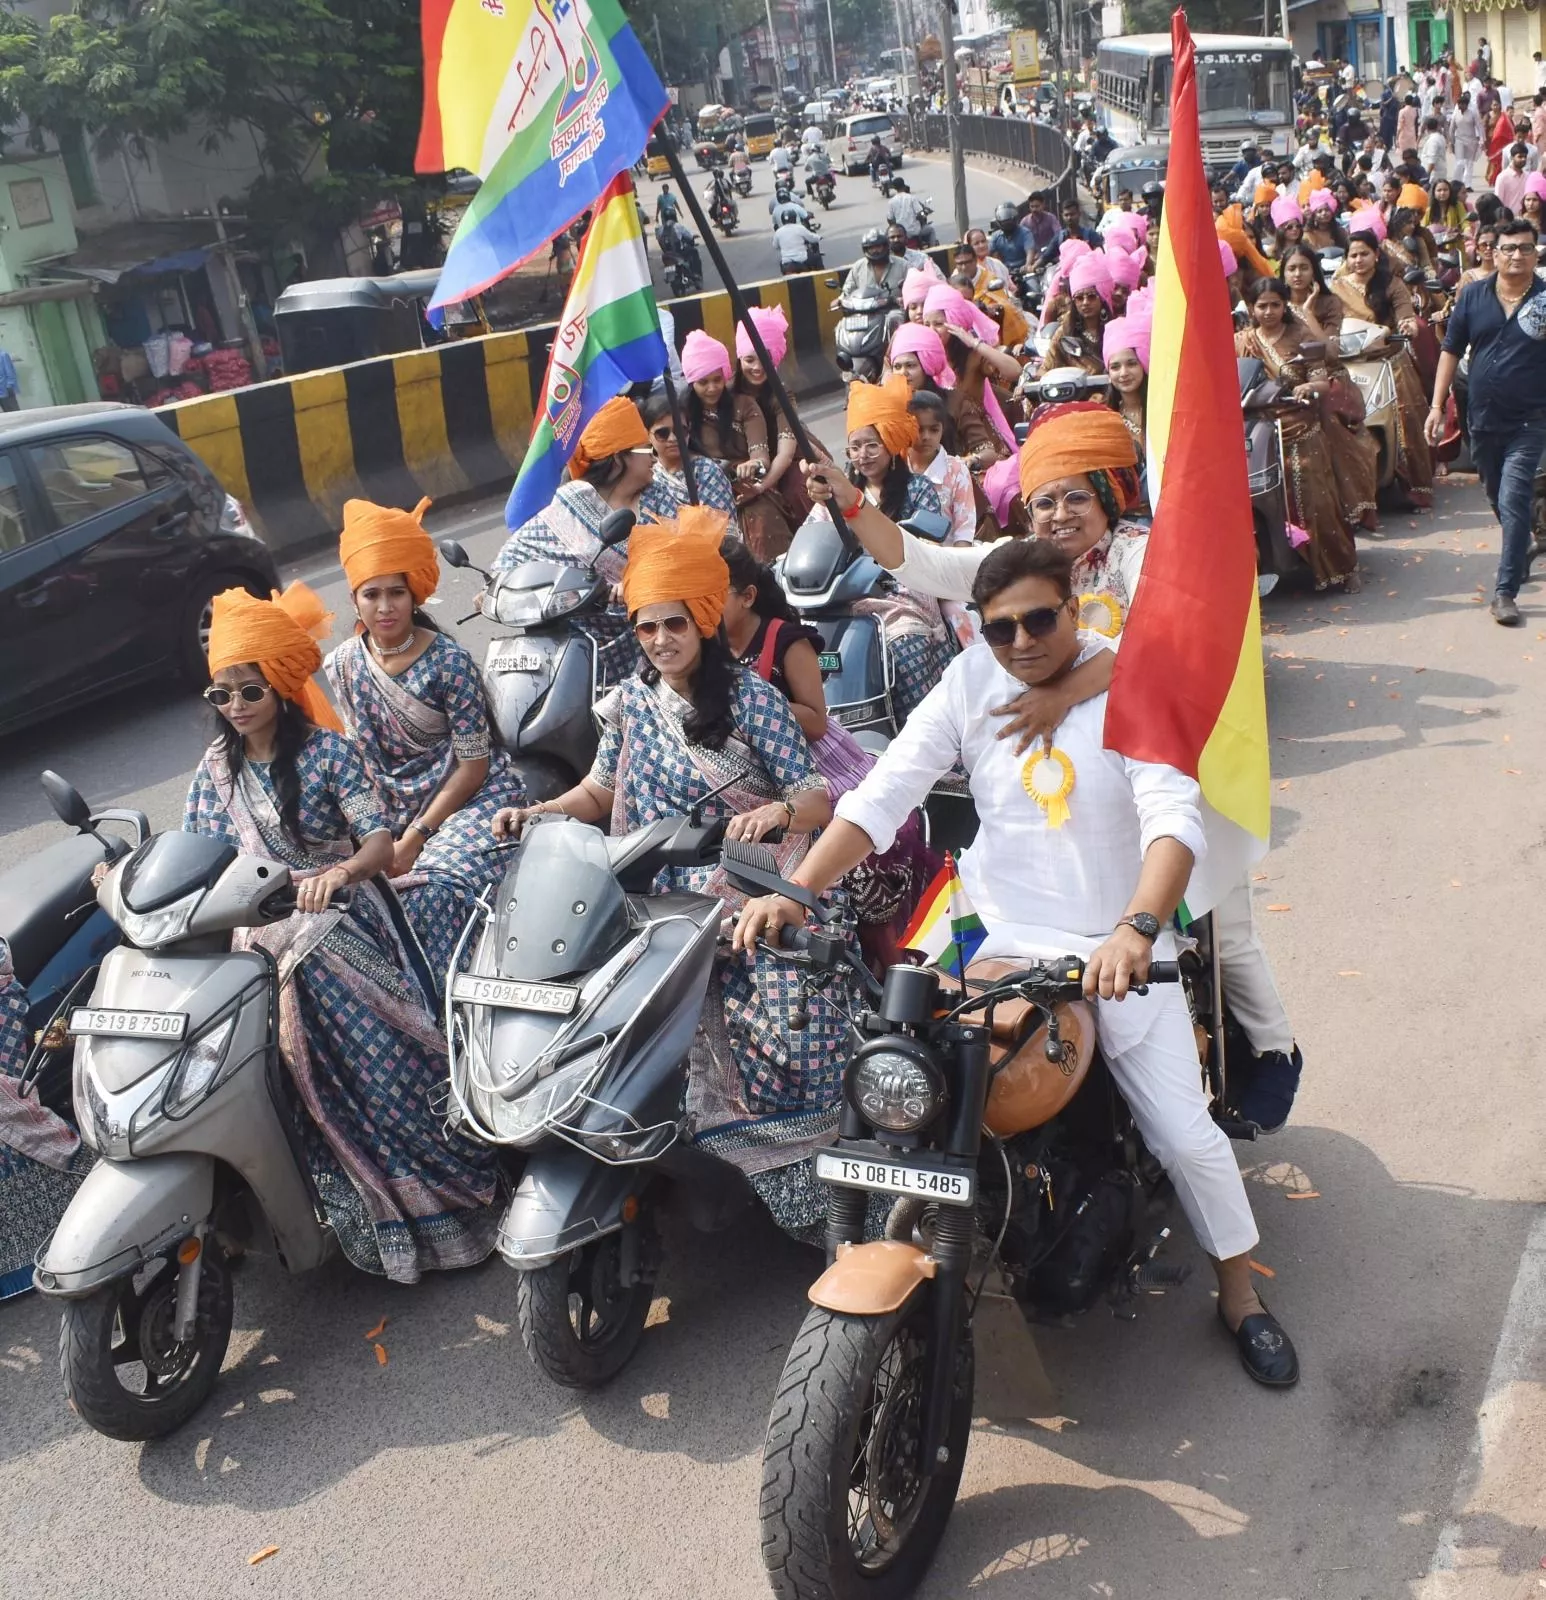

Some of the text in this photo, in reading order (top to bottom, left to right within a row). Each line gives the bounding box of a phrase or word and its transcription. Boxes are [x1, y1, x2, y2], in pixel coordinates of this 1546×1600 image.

[131, 970, 172, 980] HONDA
[841, 1161, 962, 1195] TS 08 EL 5485
